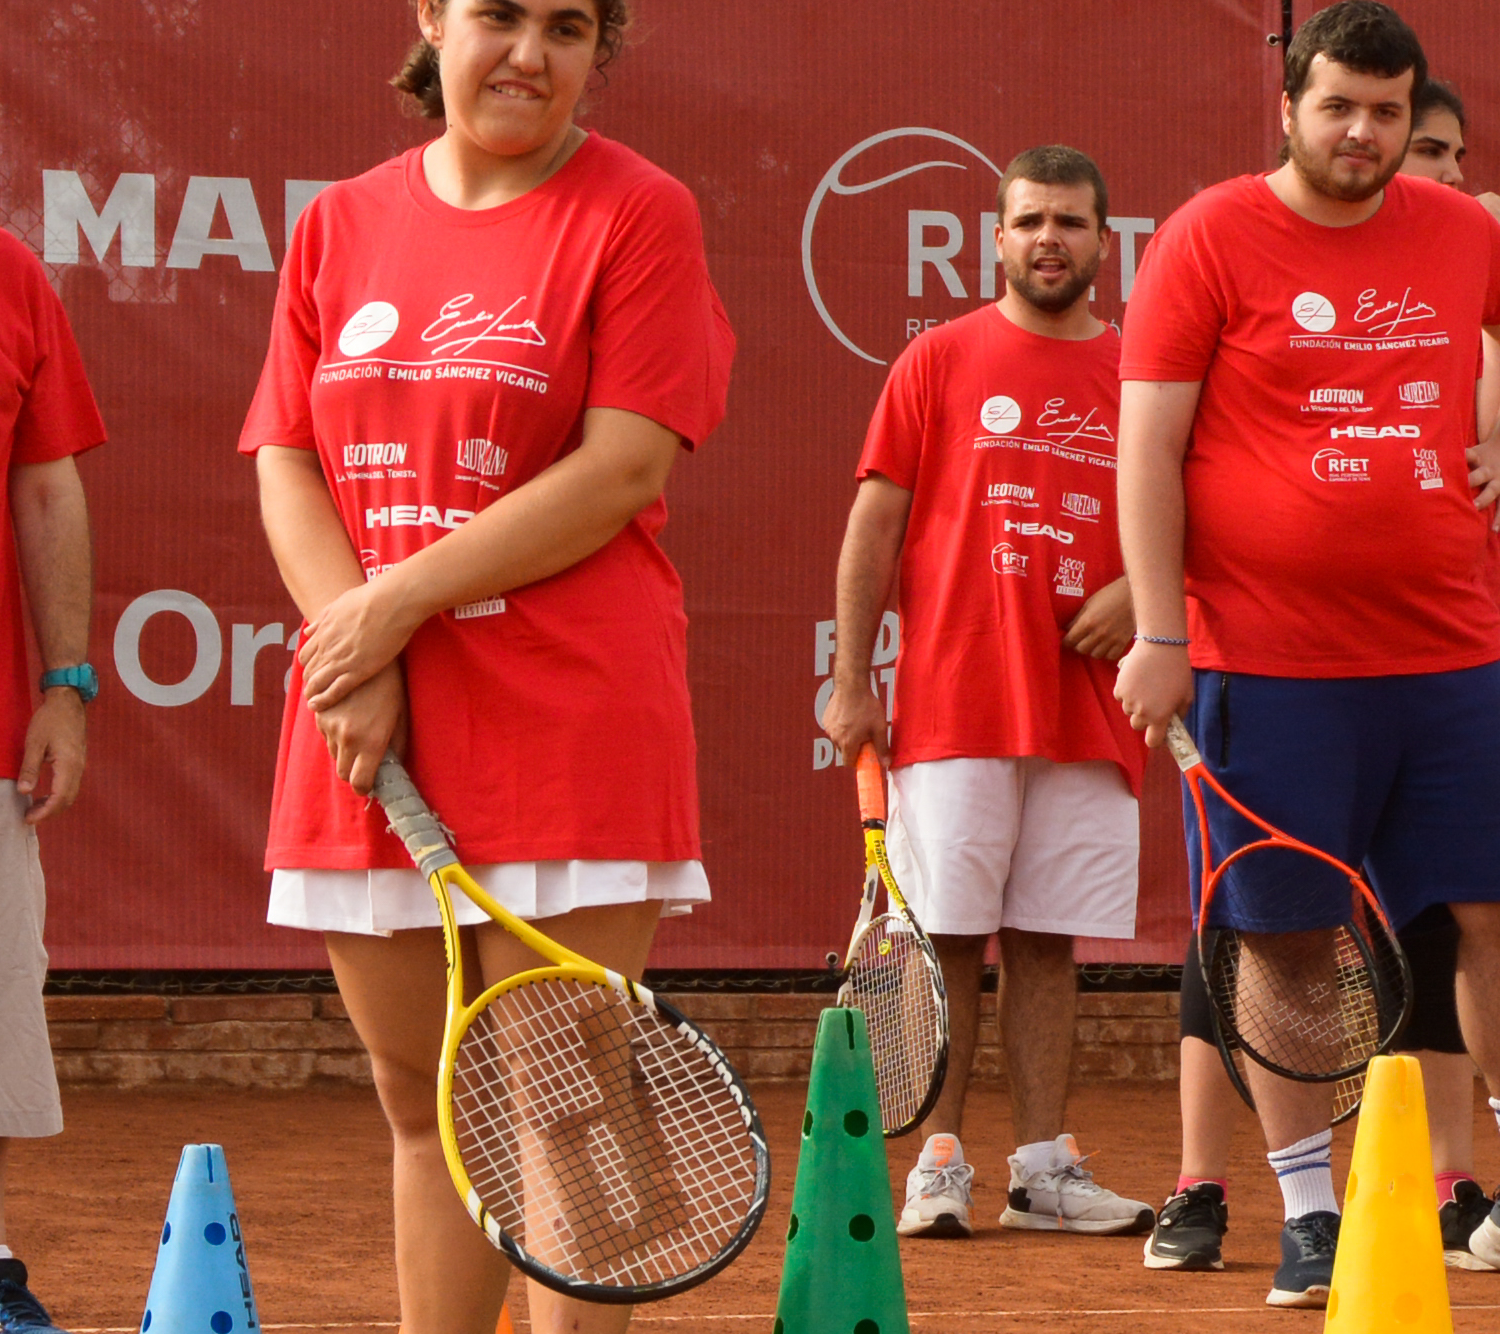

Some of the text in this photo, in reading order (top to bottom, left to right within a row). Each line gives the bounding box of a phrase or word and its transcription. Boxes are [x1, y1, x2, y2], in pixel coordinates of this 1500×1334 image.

[1289, 336, 1450, 351] FUNDACIÓN EMILIO SÁNCHEZ VICARIO
[319, 363, 549, 395] FUNDACIÓN EMILIO SÁNCHEZ VICARIO
[1309, 388, 1365, 405] LEOTRON
[1330, 424, 1421, 440] HEAD
[1328, 458, 1370, 473] RFET
[987, 483, 1036, 500] LEOTRON
[365, 504, 476, 530] HEAD
[1003, 519, 1075, 545] HEAD
[1002, 552, 1029, 568] RFET
[112, 589, 301, 707] Or
[229, 1212, 256, 1329] HEAD
